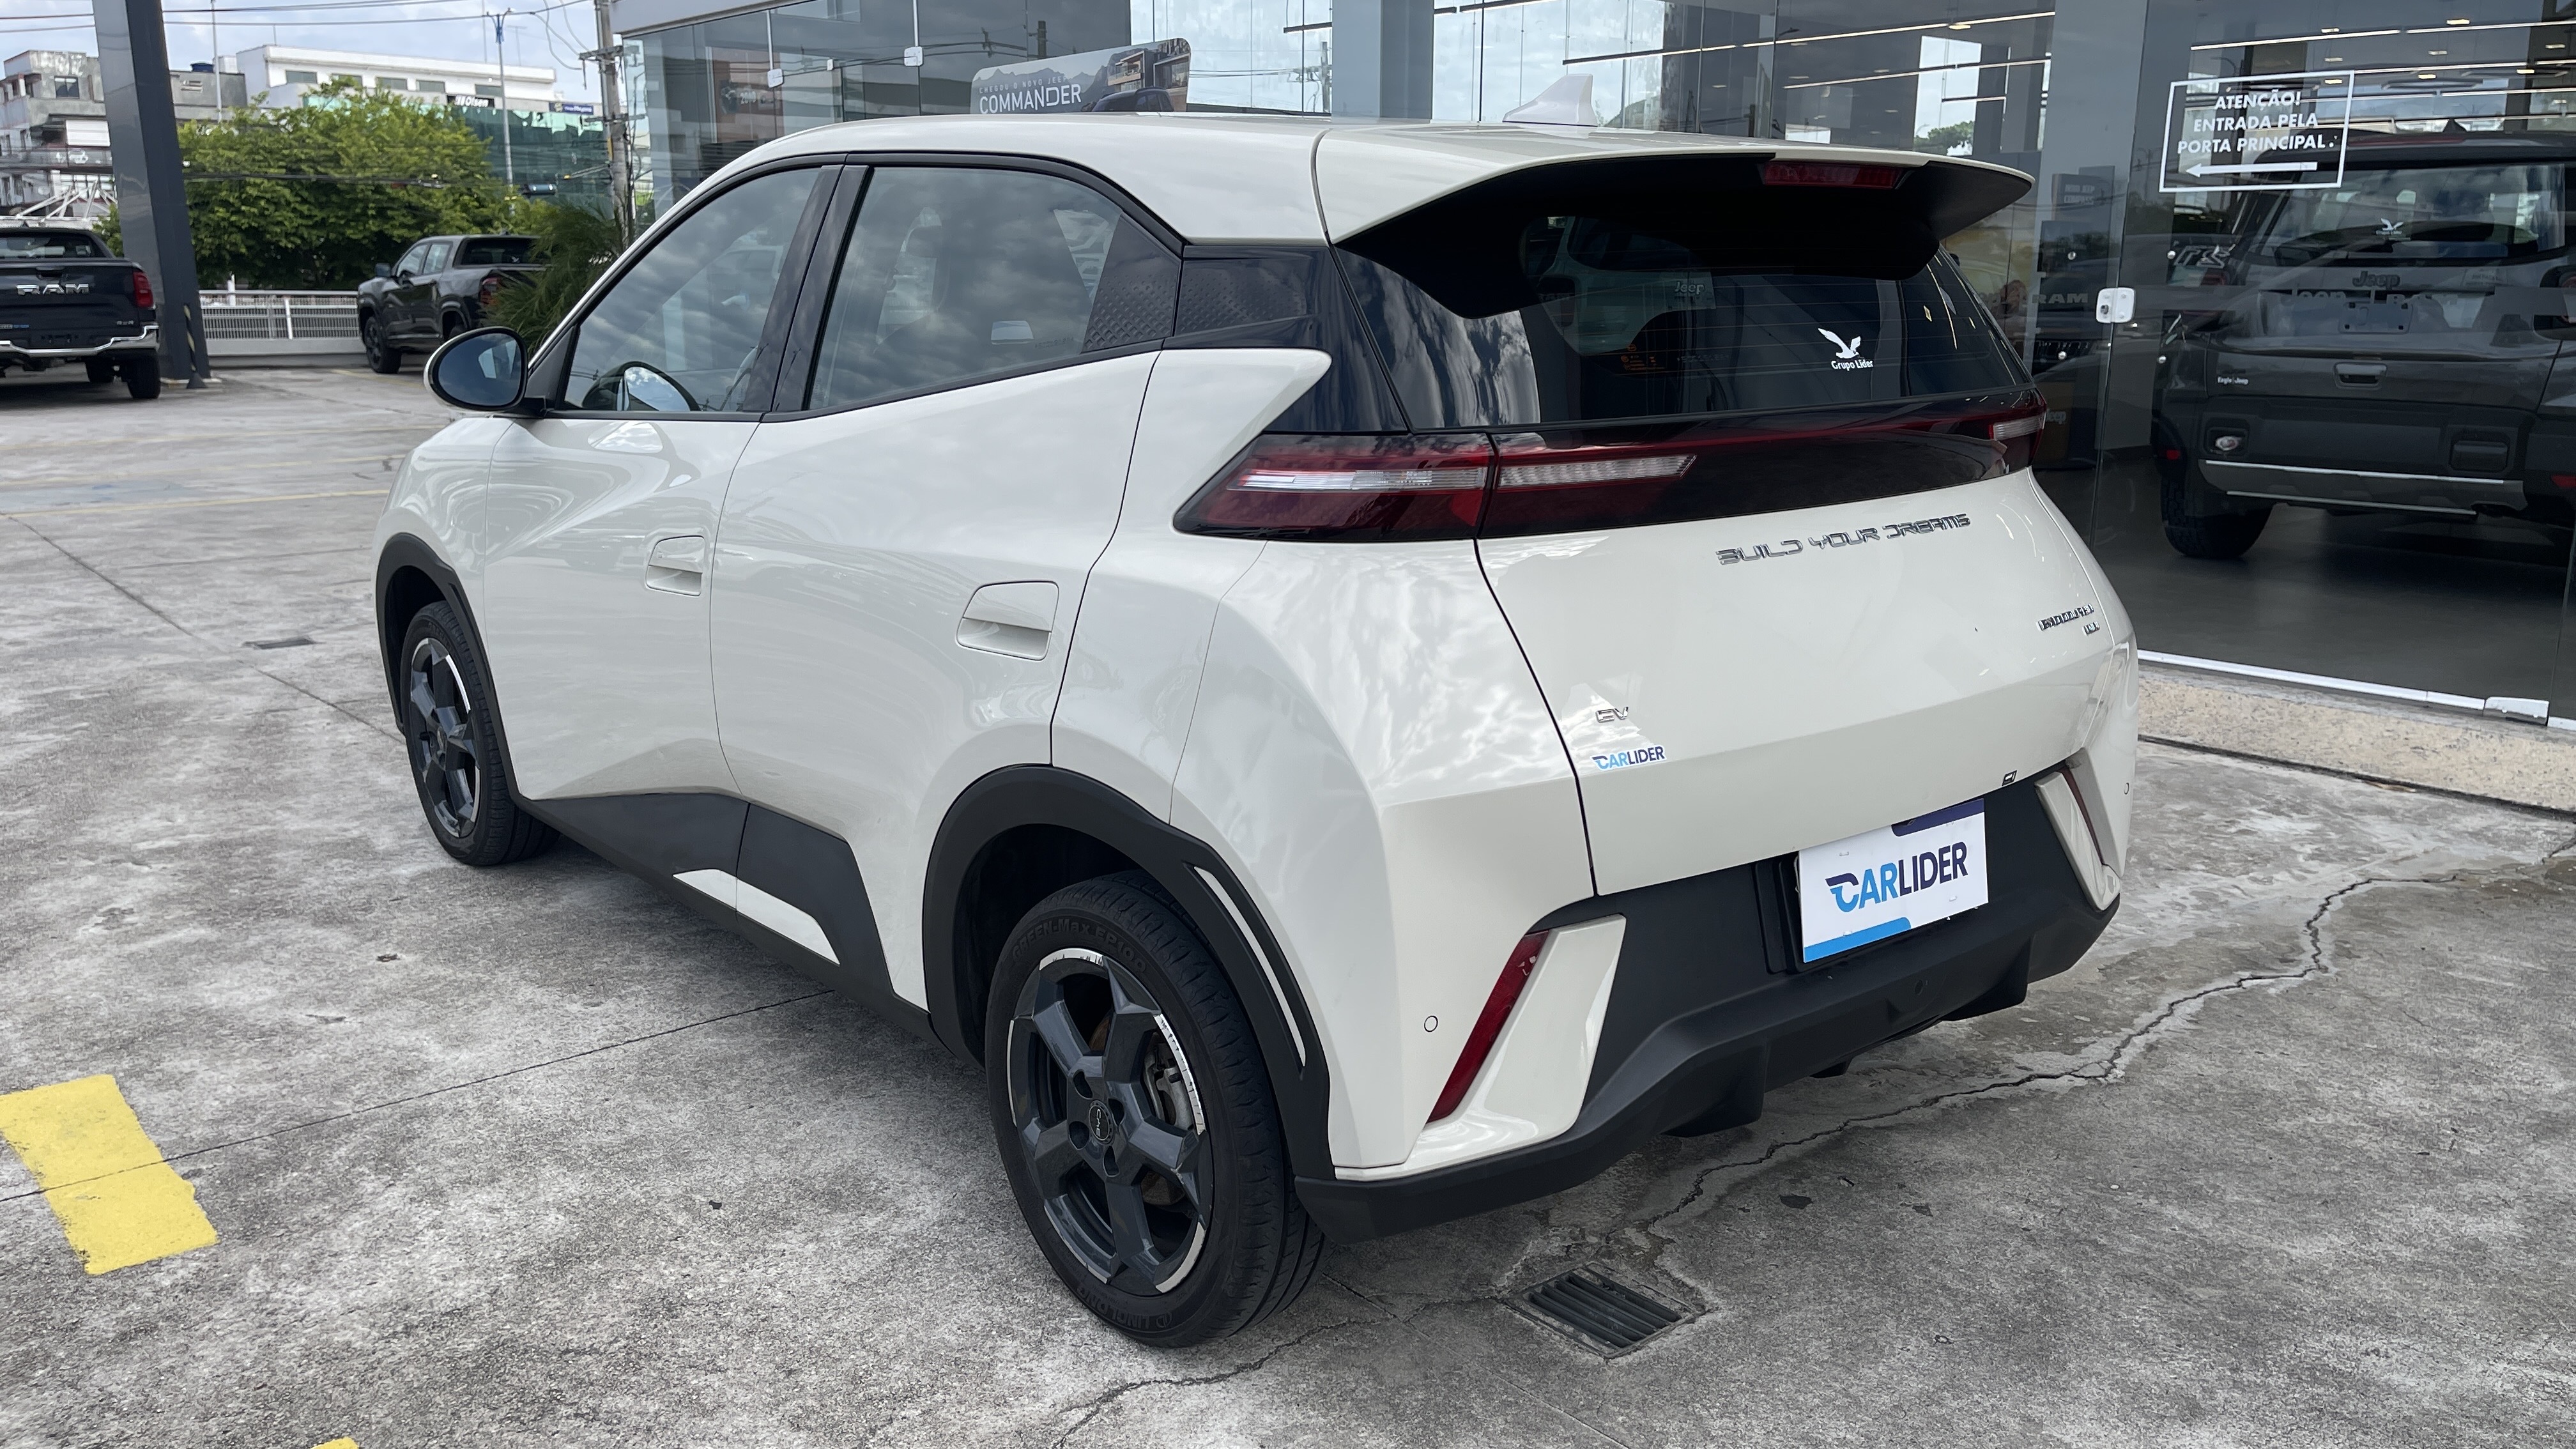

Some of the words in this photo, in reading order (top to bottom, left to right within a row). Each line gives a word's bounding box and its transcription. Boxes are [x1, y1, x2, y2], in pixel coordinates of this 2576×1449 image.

[979, 84, 1009, 94] CHEGOU
[1023, 79, 1043, 88] NOVO
[1047, 76, 1068, 85] JEEP
[979, 83, 1082, 114] COMMANDER
[2214, 89, 2301, 111] ATENÇÃO!
[2194, 116, 2272, 133] ENTRADA
[2278, 113, 2318, 128] PELA
[2177, 135, 2232, 155] PORTA
[17, 284, 89, 296] RAM
[1675, 281, 1705, 296] Jeep
[2352, 271, 2400, 290] Jeep
[1830, 360, 1855, 371] Grupo
[1715, 539, 1804, 565] BUILD
[1807, 528, 1881, 549] YOUR
[1882, 513, 1972, 539] DREAMS
[1595, 706, 1629, 723] EV
[1591, 746, 1666, 770] CARLIDER
[1825, 841, 1968, 913] CARLIDER
